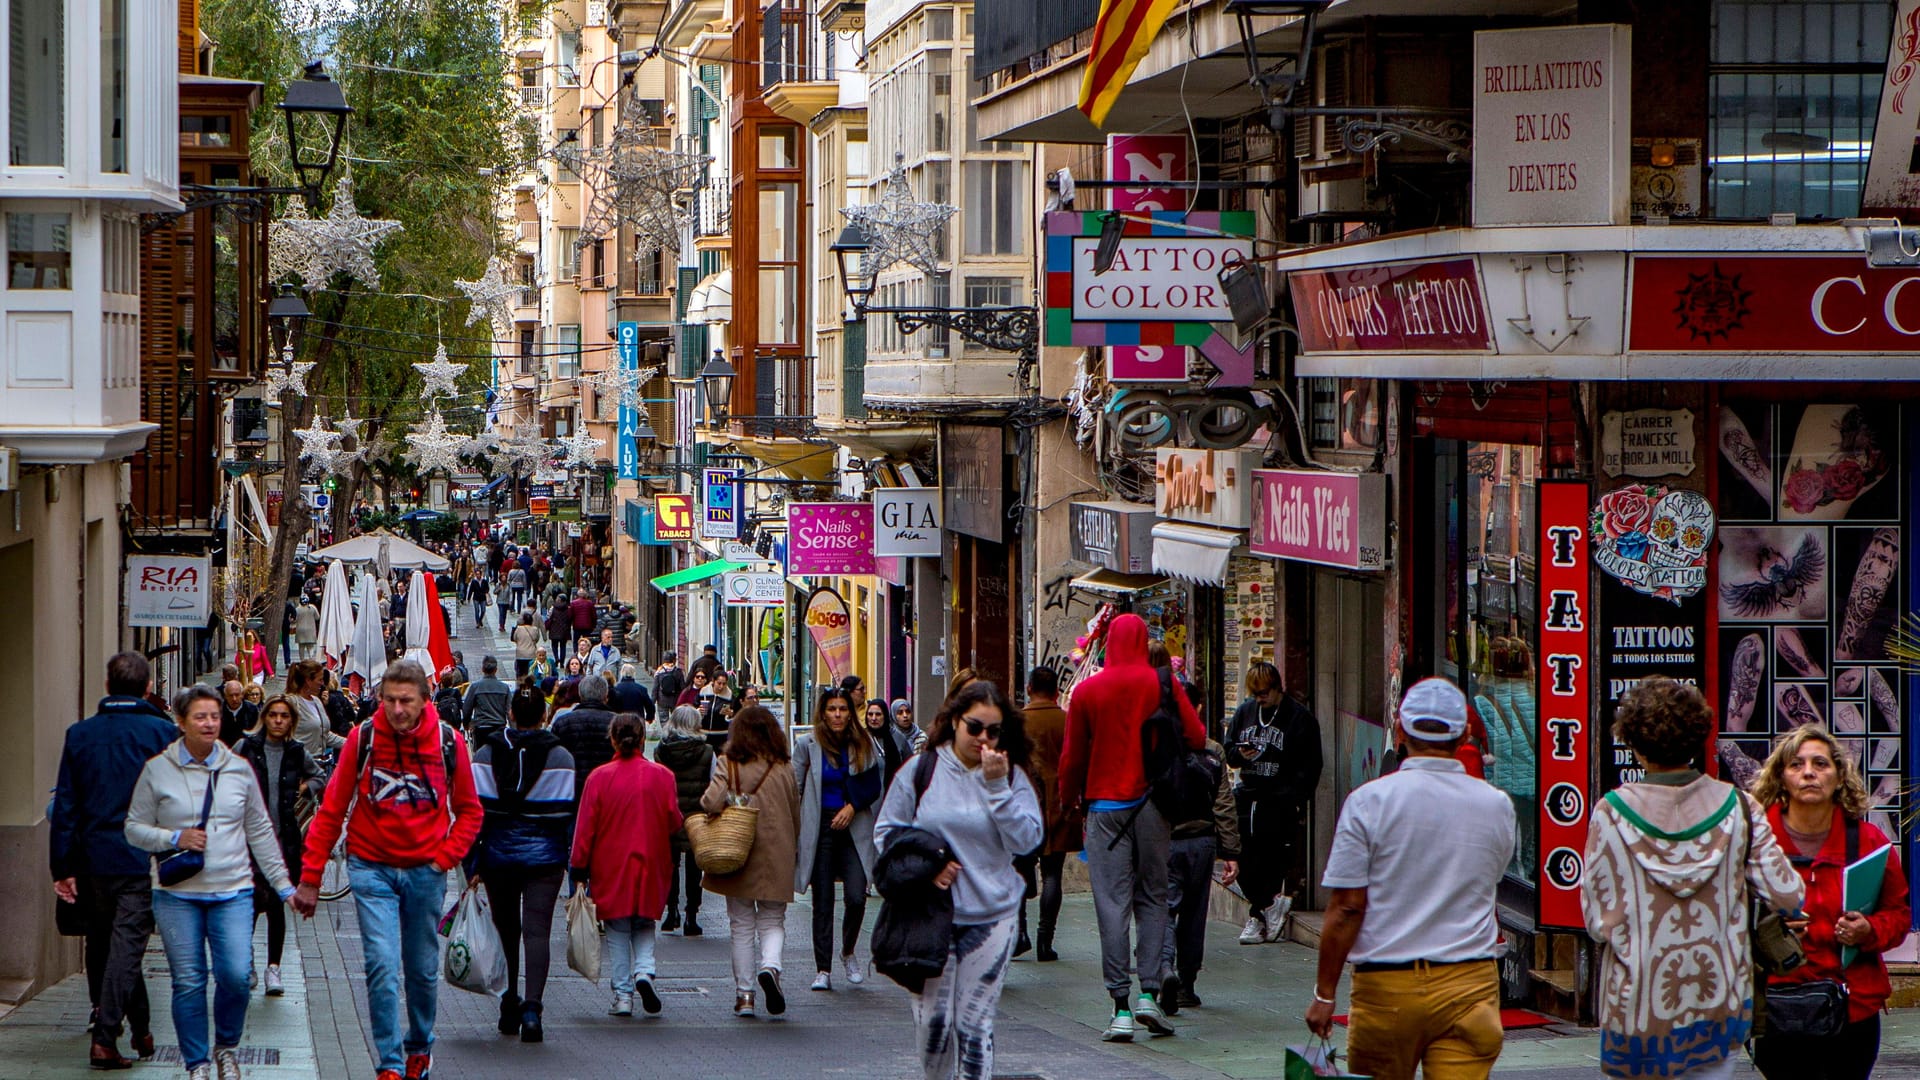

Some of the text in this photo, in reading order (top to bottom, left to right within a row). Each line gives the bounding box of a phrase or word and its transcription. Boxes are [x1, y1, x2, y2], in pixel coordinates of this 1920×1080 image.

[1484, 60, 1603, 93] BRILLANTITOS
[1515, 112, 1571, 142] EN LOS
[1508, 162, 1577, 193] DIENTES
[1084, 285, 1231, 309] COLOR
[1317, 277, 1478, 339] COLORS TATTOO
[1810, 275, 1920, 335] CO
[1624, 416, 1673, 429] CARRER
[1623, 431, 1679, 447] FRANCESC
[624, 443, 633, 476] LUX
[1606, 450, 1692, 466] DE BORJA MOLL
[709, 473, 731, 484] TIN
[709, 508, 731, 520] TIN
[881, 501, 939, 529] GIA
[1269, 482, 1350, 554] Nails Viet
[658, 530, 691, 538] TABACS
[815, 518, 852, 534] Nails
[894, 530, 929, 541] mia
[796, 526, 859, 549] Sense
[140, 566, 198, 585] RIA
[1597, 548, 1706, 585] COLORS TATTOO
[140, 584, 199, 593] Menorca
[1613, 626, 1695, 648] TATTOOS
[1612, 653, 1695, 664] DE TODOS LOS ESTILOS
[1543, 525, 1585, 892] TATTOO
